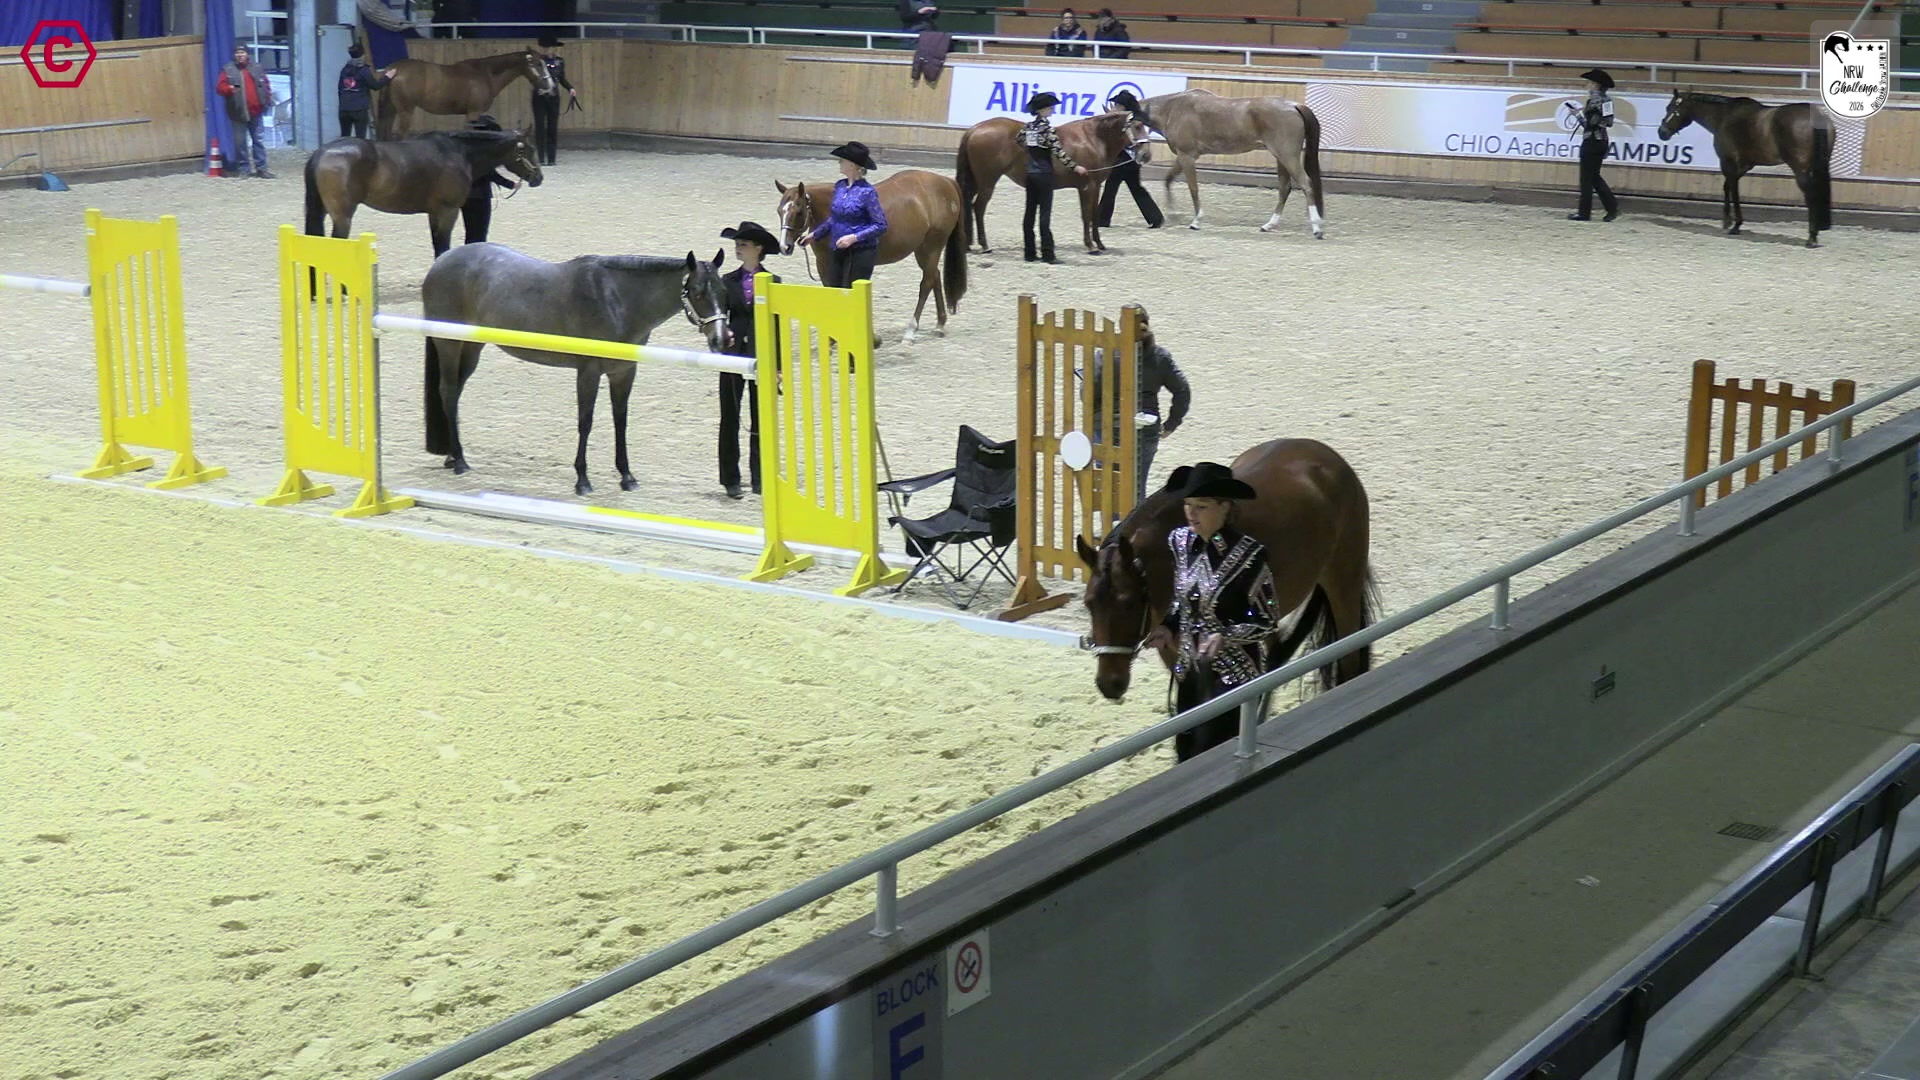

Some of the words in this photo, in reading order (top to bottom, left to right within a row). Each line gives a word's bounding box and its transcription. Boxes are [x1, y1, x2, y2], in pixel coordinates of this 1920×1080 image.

[985, 81, 1096, 116] Allnz
[1444, 133, 1502, 154] CHIO
[1506, 136, 1581, 159] Aachen
[1605, 142, 1694, 165] AMPUS
[877, 964, 939, 1016] BLOCK
